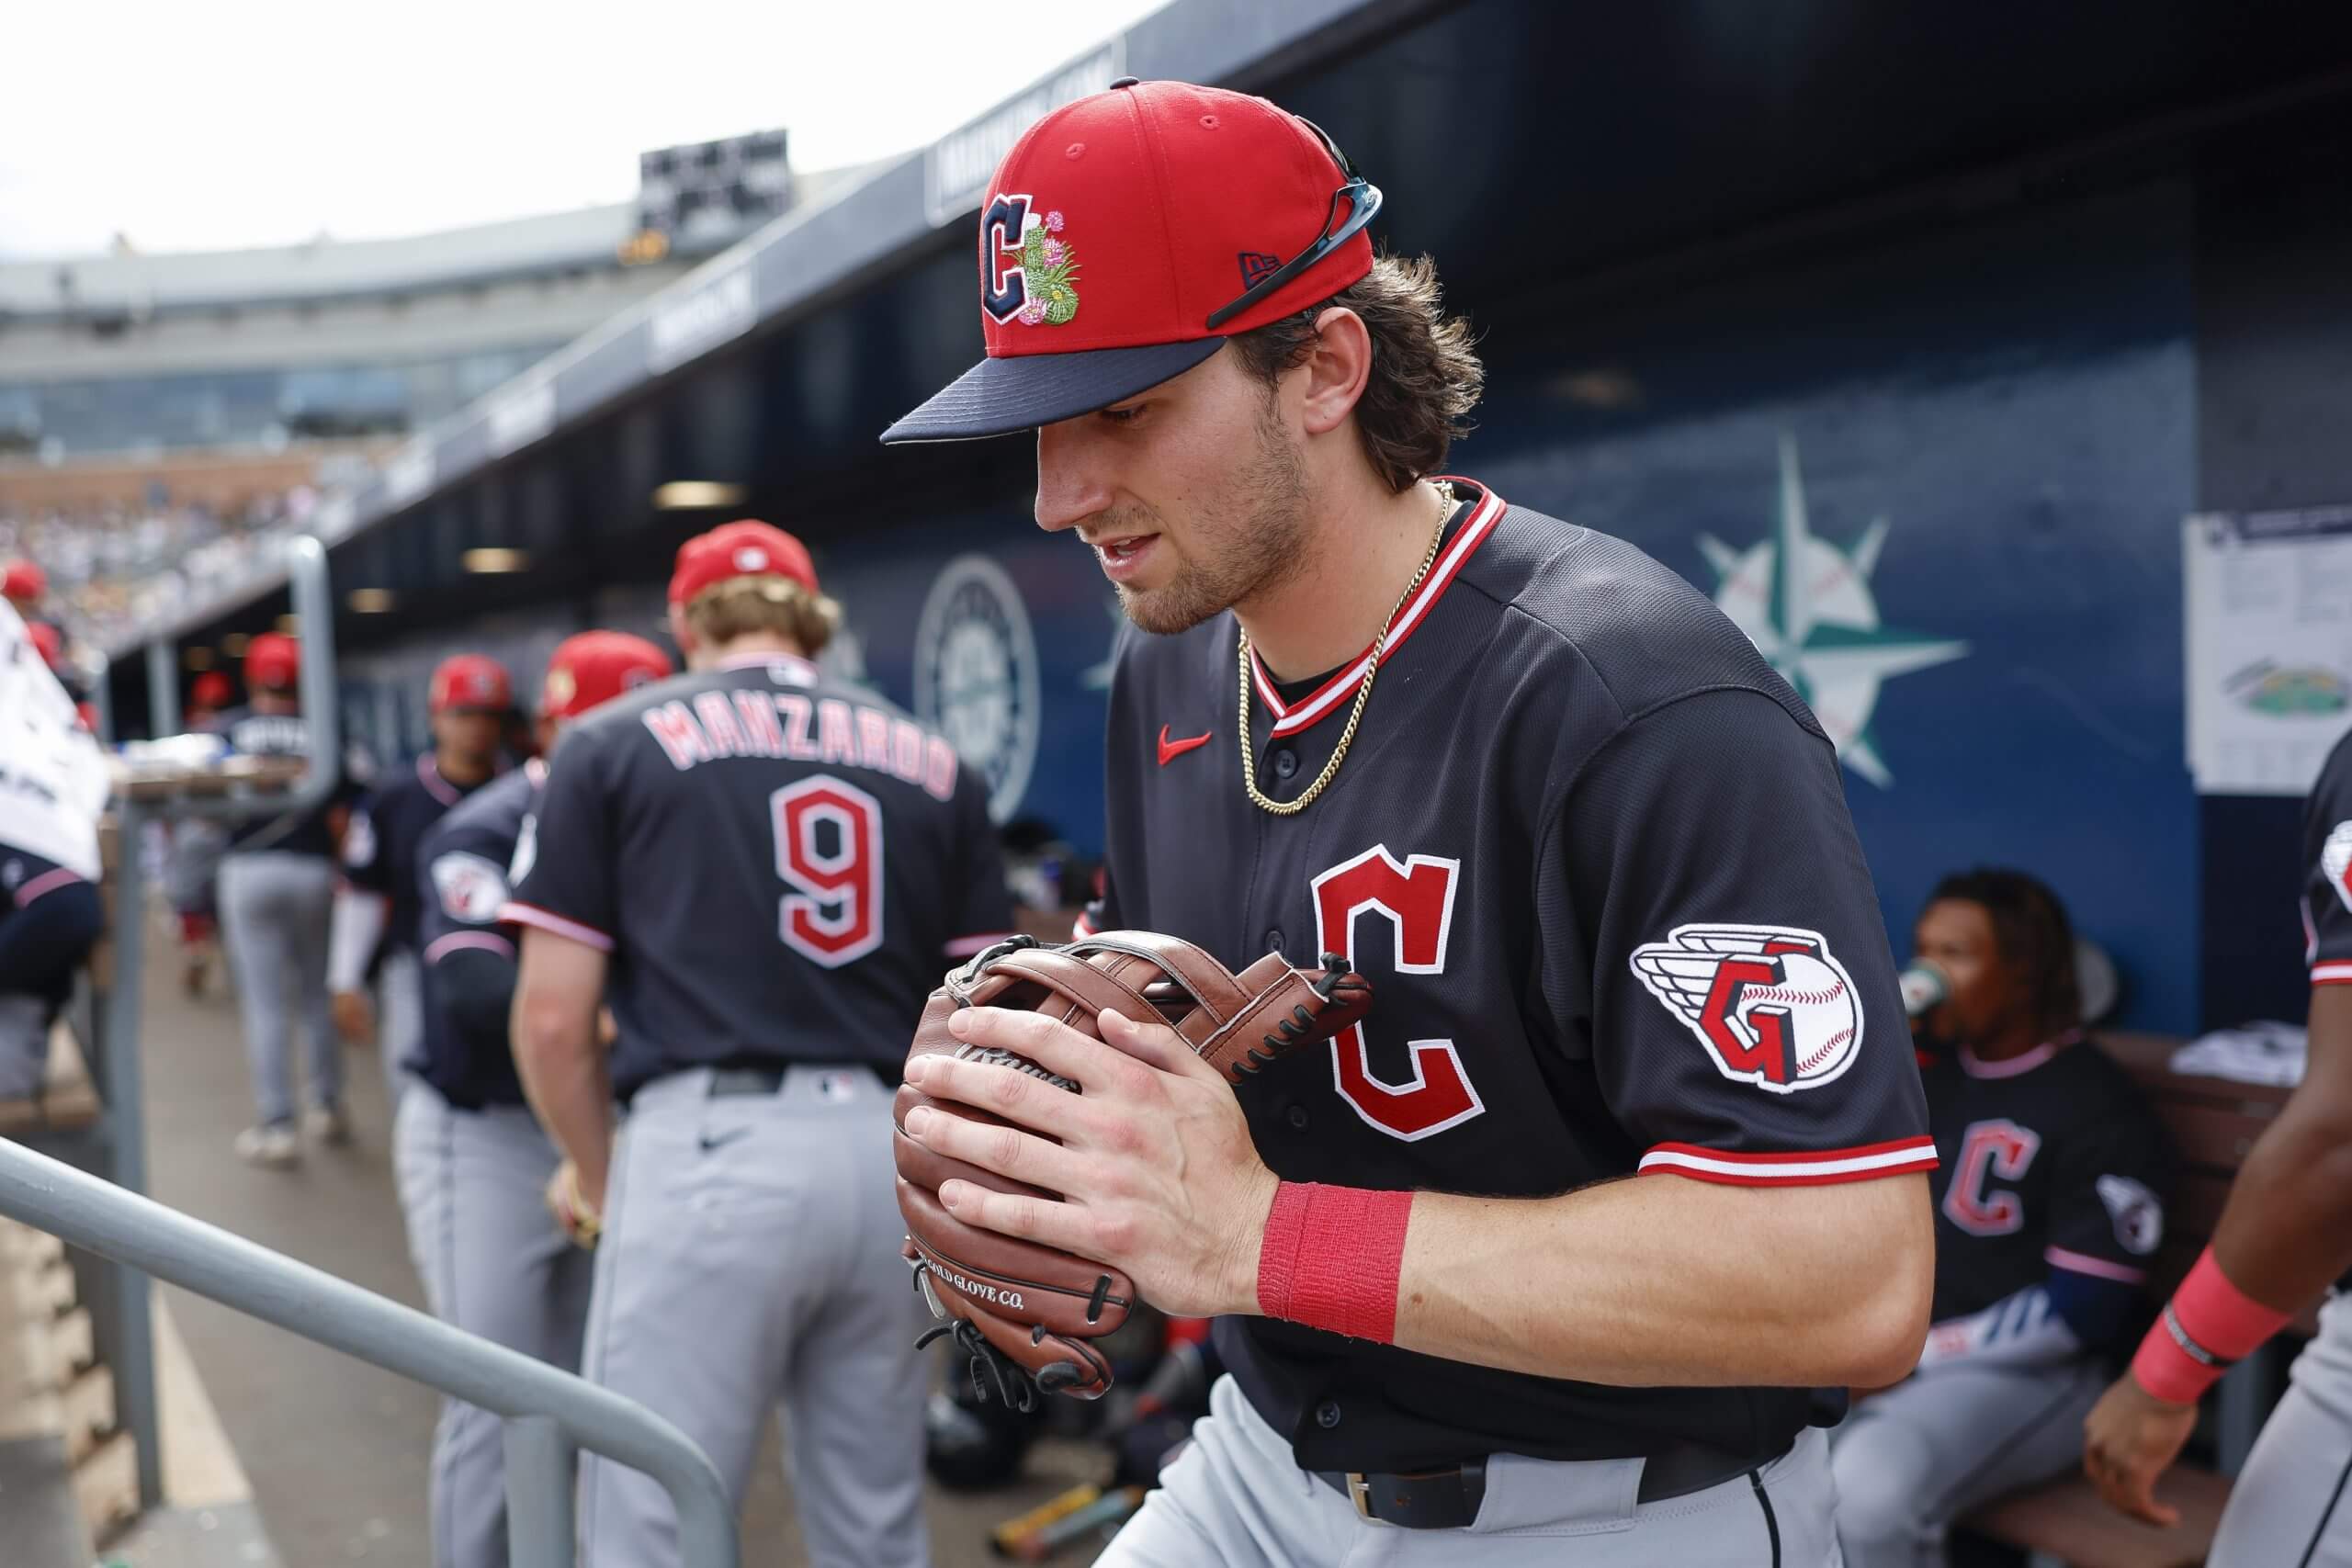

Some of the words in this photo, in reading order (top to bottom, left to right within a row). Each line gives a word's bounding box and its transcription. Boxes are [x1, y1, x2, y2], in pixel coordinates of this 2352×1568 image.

[982, 193, 1034, 325] C
[641, 689, 958, 802] MANZARDO
[770, 774, 884, 969] 9
[1310, 843, 1486, 1143] C
[1941, 1118, 2041, 1236] C
[954, 1274, 997, 1303] GLOVE
